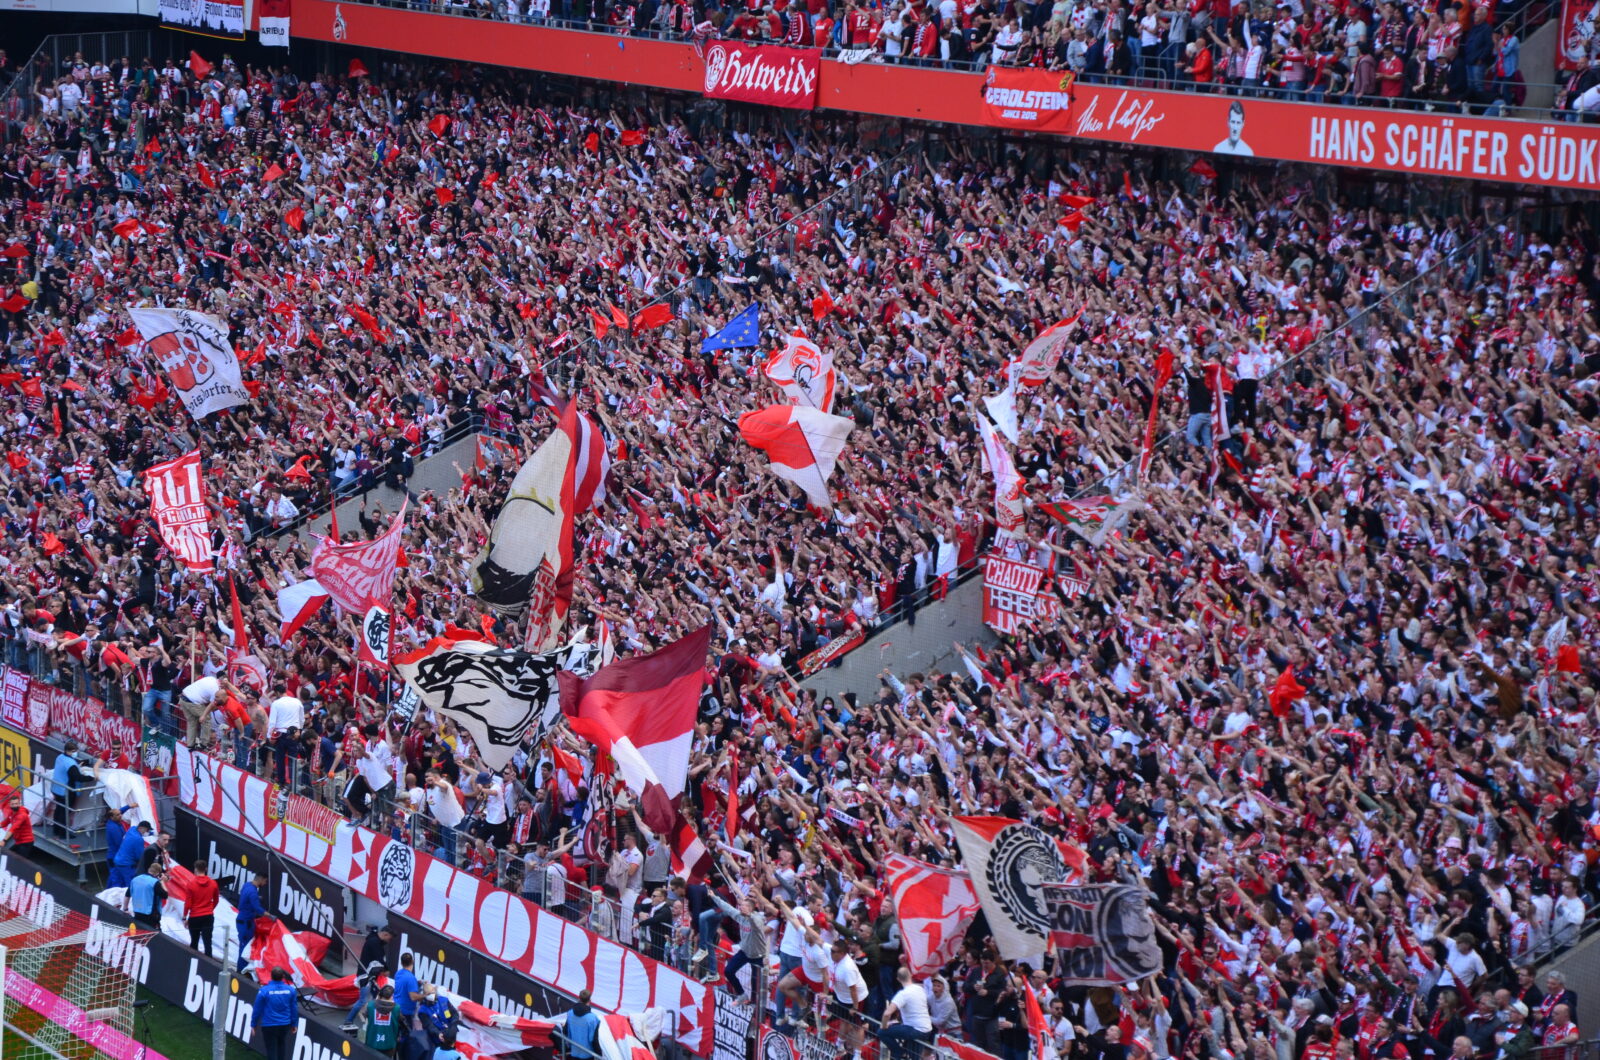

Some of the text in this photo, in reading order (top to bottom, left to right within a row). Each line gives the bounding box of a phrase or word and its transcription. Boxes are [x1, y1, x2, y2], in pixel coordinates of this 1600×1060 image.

[856, 15, 869, 27] 12
[721, 49, 816, 97] Holweide
[985, 86, 1070, 111] GEROLSTEIN
[1001, 109, 1038, 121] SINCE 2012
[1310, 116, 1600, 185] HANS SCHÄFER SÜDK
[986, 558, 1044, 595] CHAOTIX
[175, 741, 707, 1052] WILDE HORDE
[278, 871, 335, 938] bwin
[85, 903, 151, 985] bwin
[376, 1033, 386, 1042] 34
